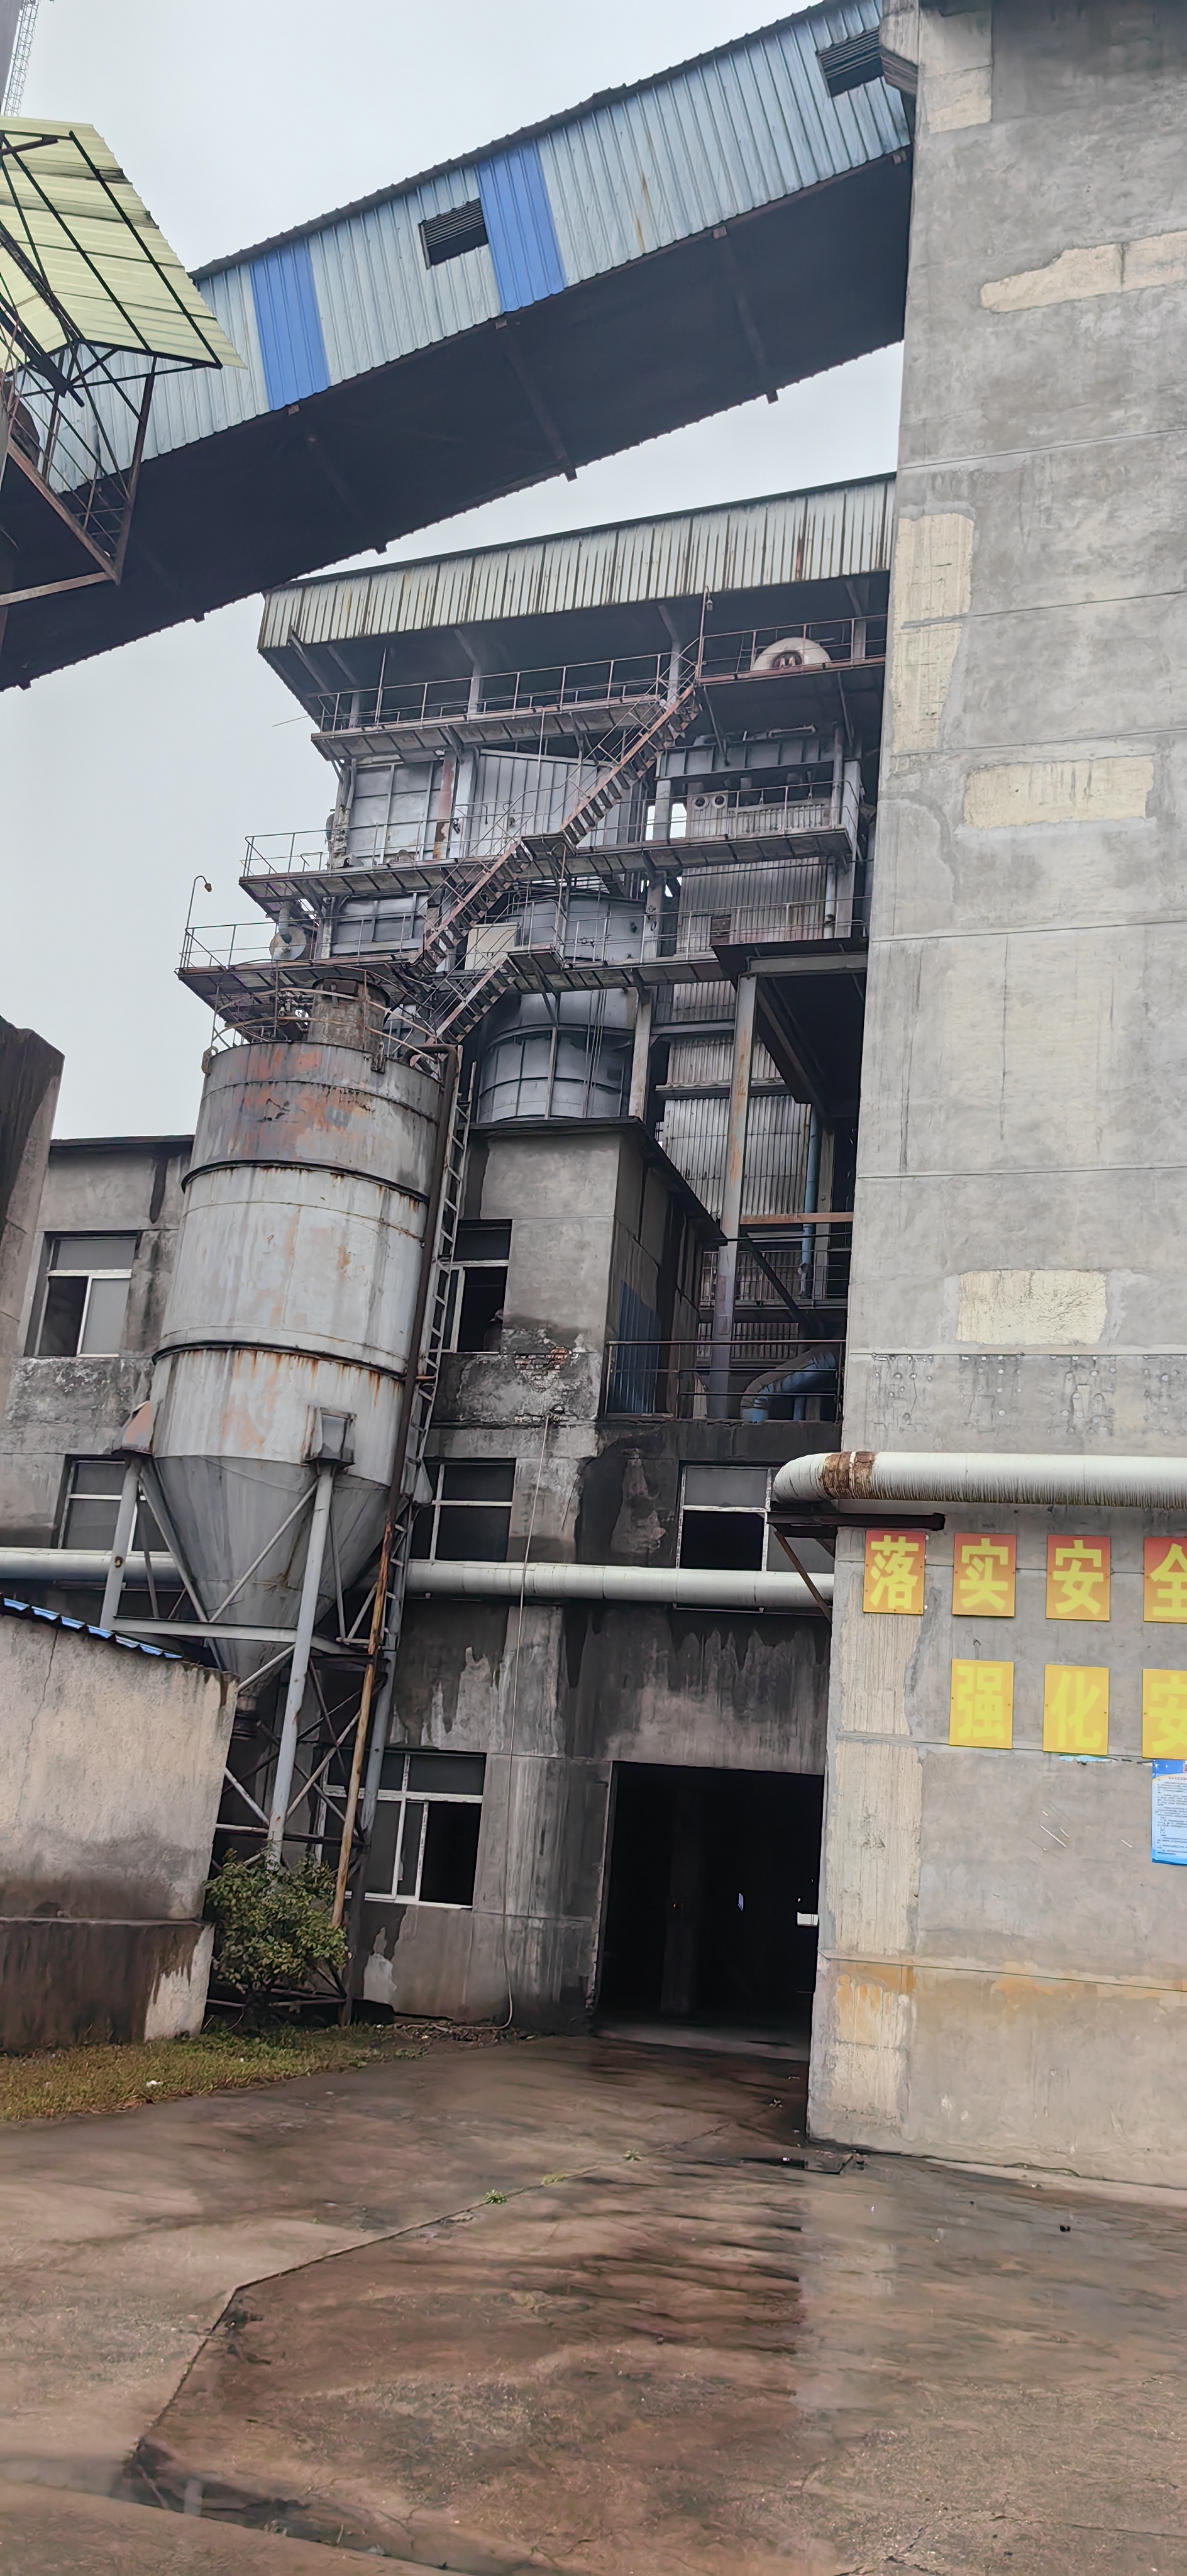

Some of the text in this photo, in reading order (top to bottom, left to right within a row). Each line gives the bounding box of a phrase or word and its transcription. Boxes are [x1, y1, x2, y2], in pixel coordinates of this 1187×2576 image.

[870, 1535, 1187, 1618] 落实安全
[956, 1665, 1187, 1753] 强化安
